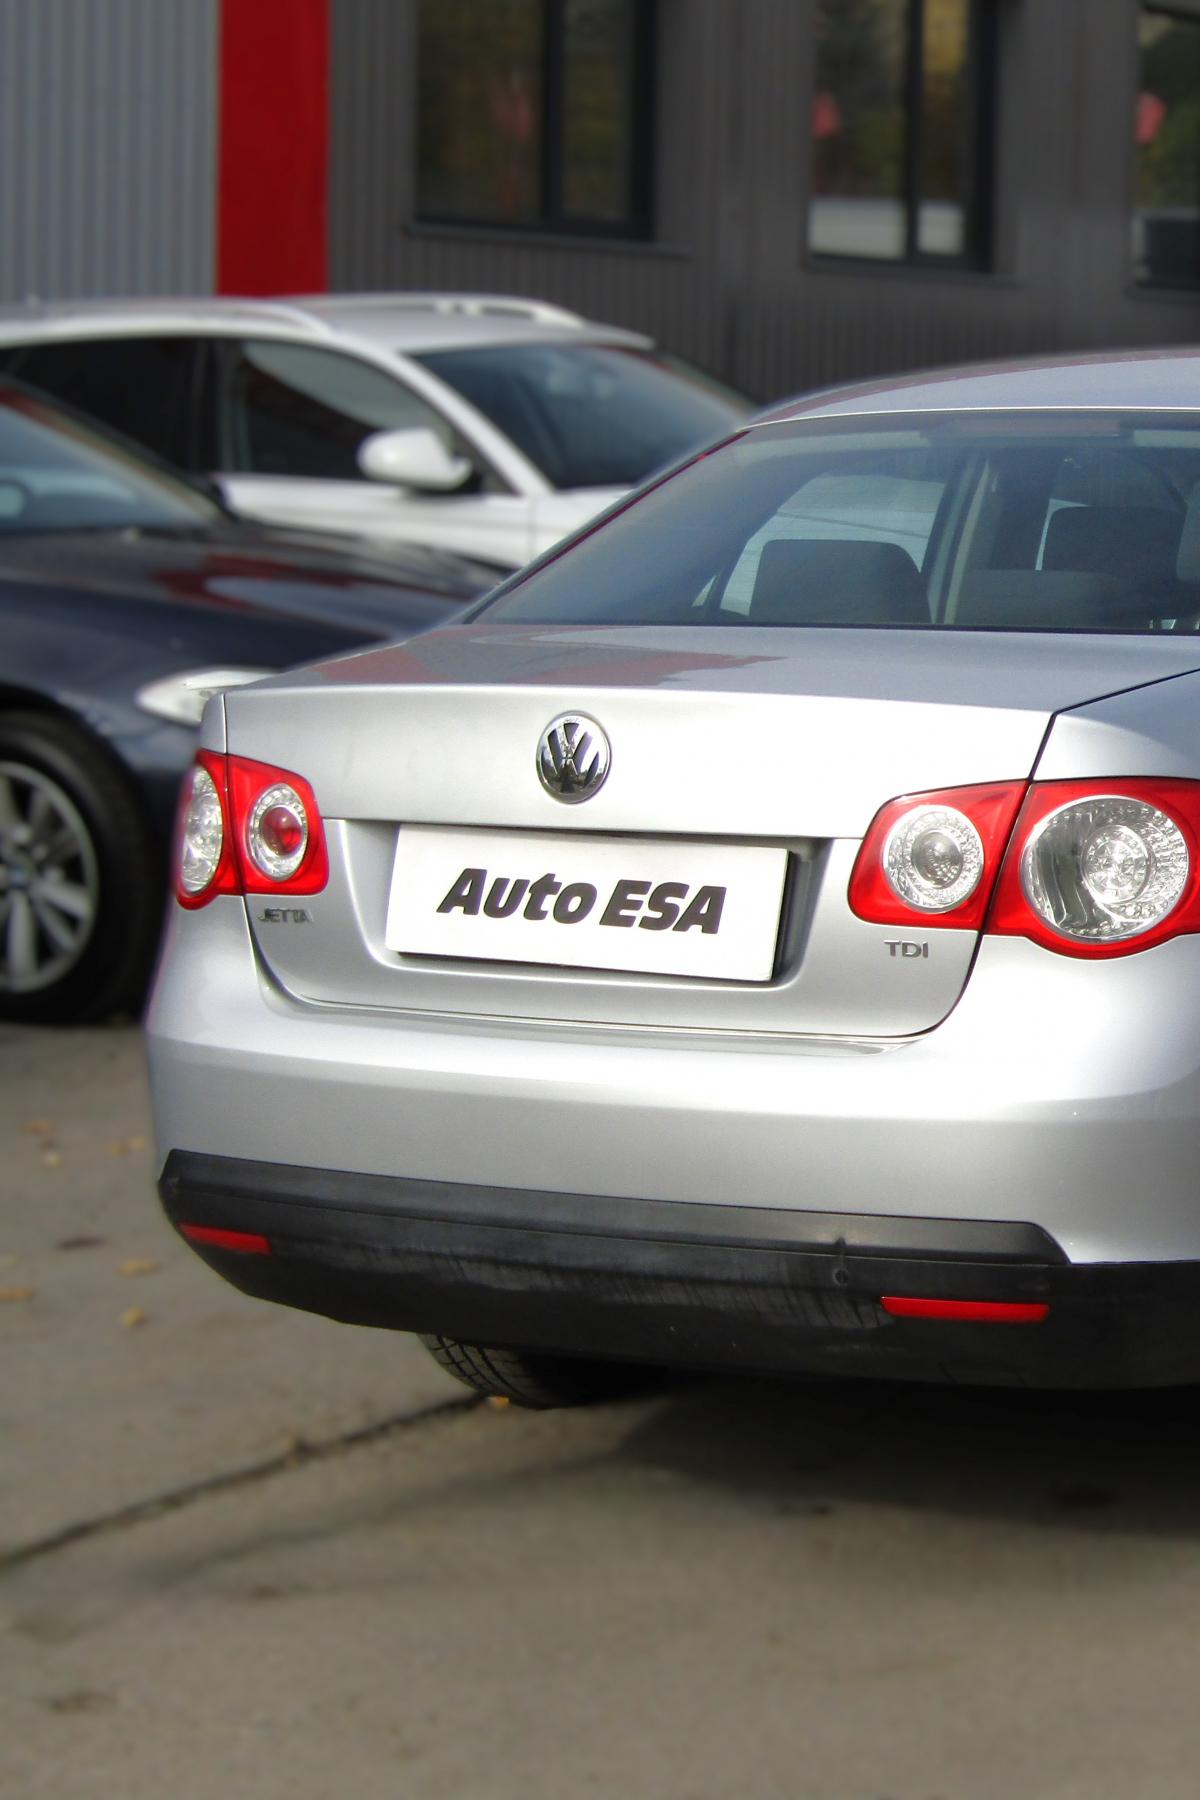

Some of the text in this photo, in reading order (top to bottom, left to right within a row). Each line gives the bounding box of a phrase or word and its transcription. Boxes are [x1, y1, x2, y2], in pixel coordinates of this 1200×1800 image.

[436, 867, 727, 934] Auto ESA
[257, 908, 314, 923] JETTA
[883, 939, 929, 958] TDI
